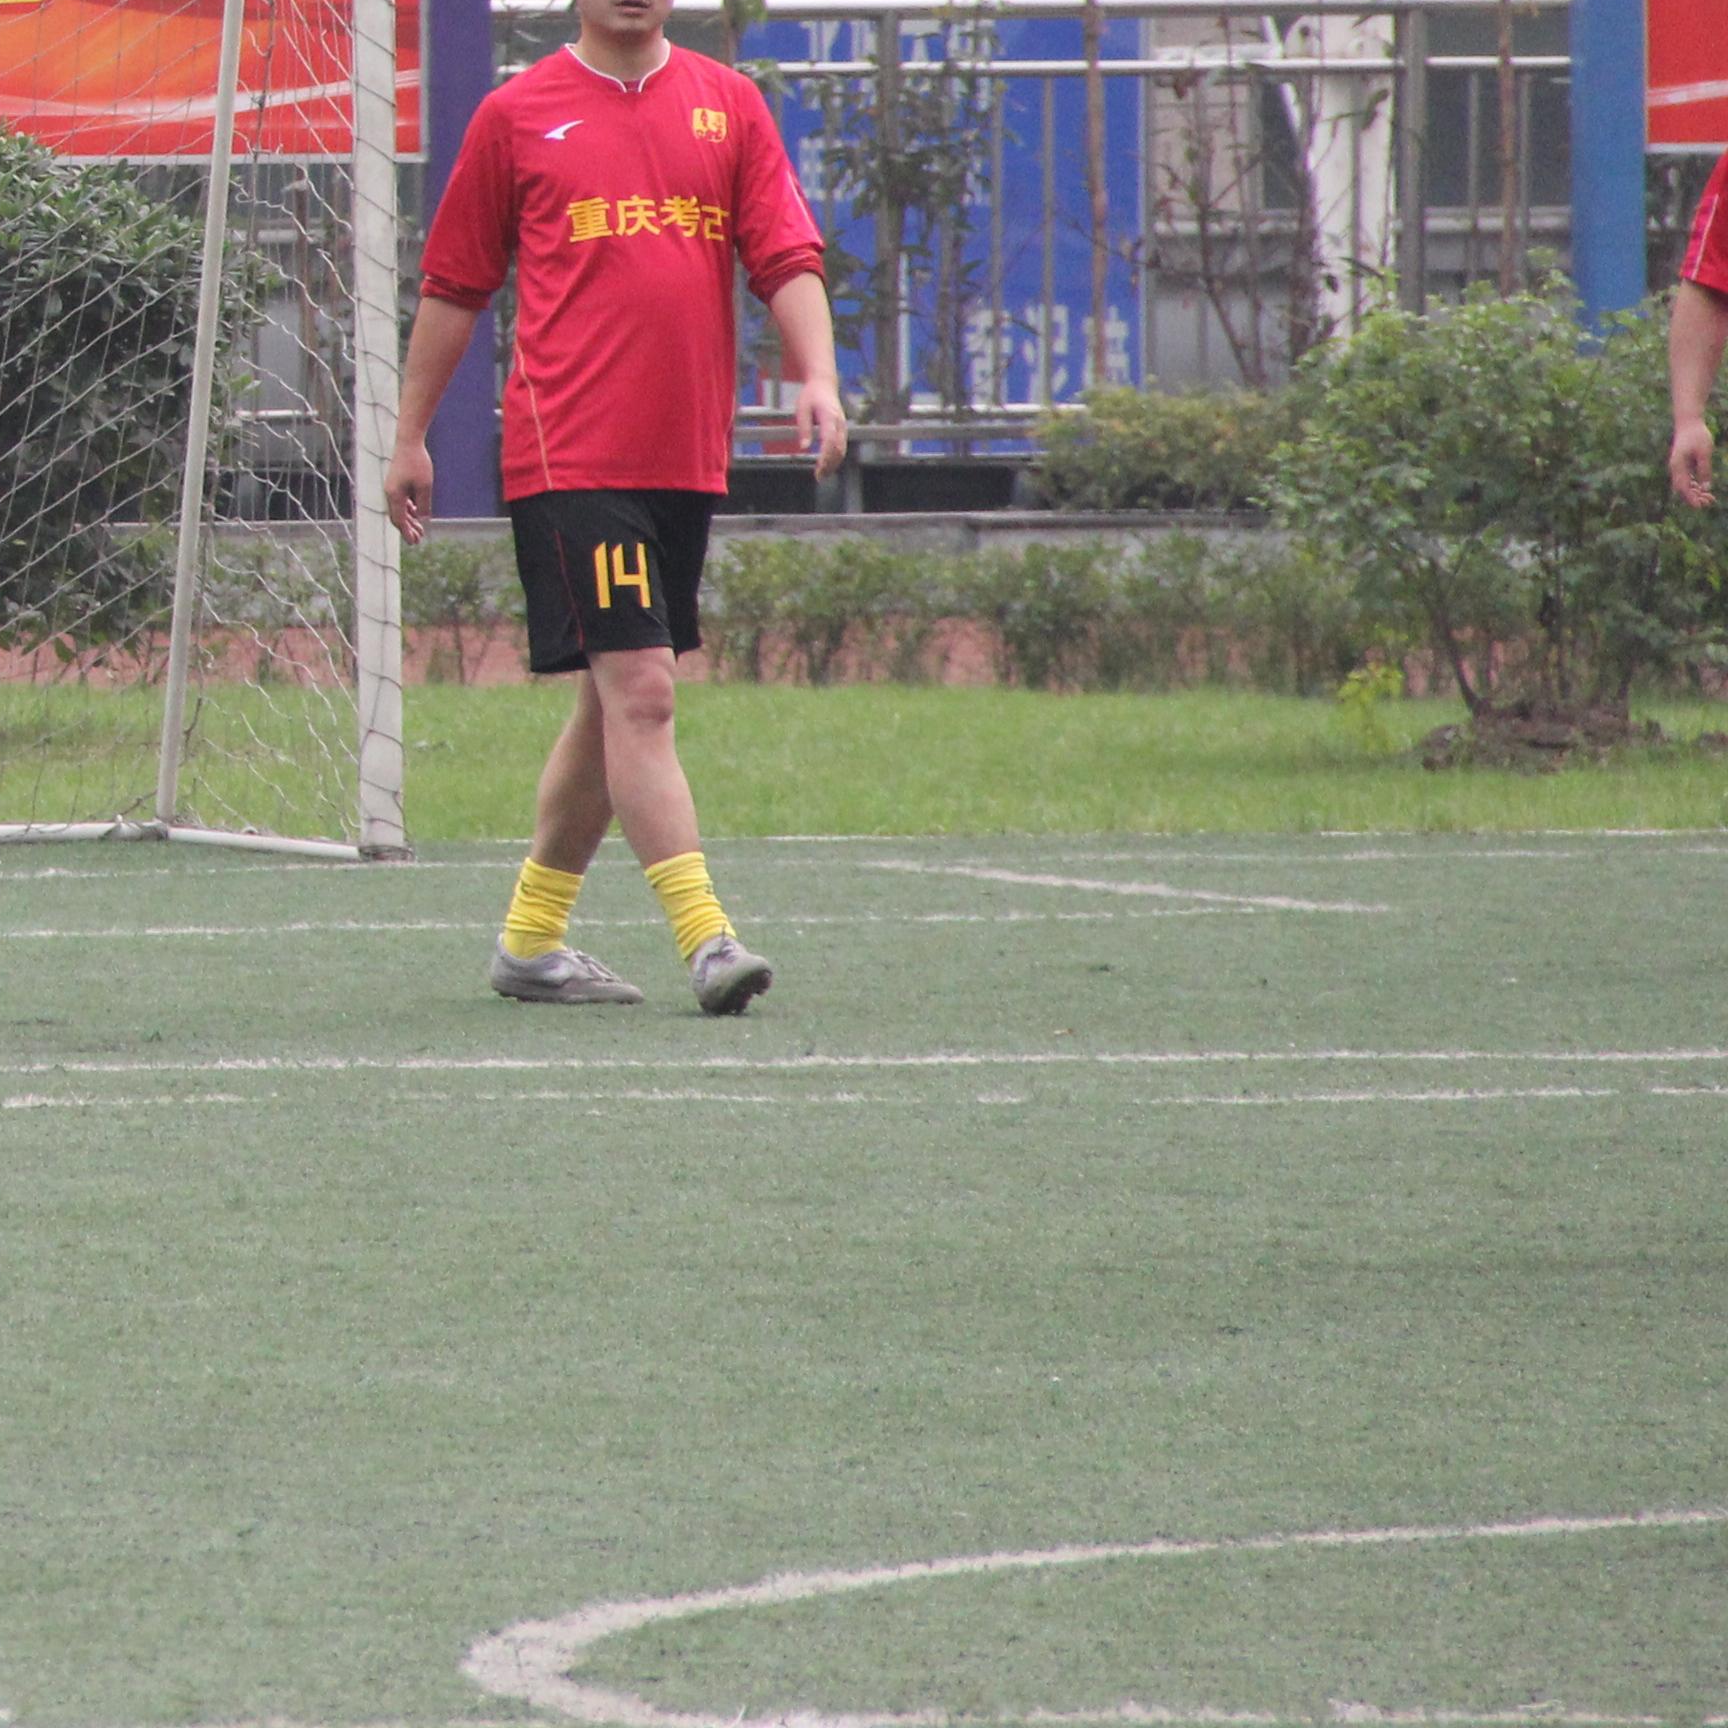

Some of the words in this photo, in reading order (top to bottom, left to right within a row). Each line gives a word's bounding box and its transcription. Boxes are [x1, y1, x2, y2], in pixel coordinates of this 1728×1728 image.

[566, 194, 730, 244] 重庆考古
[594, 541, 652, 609] 14
